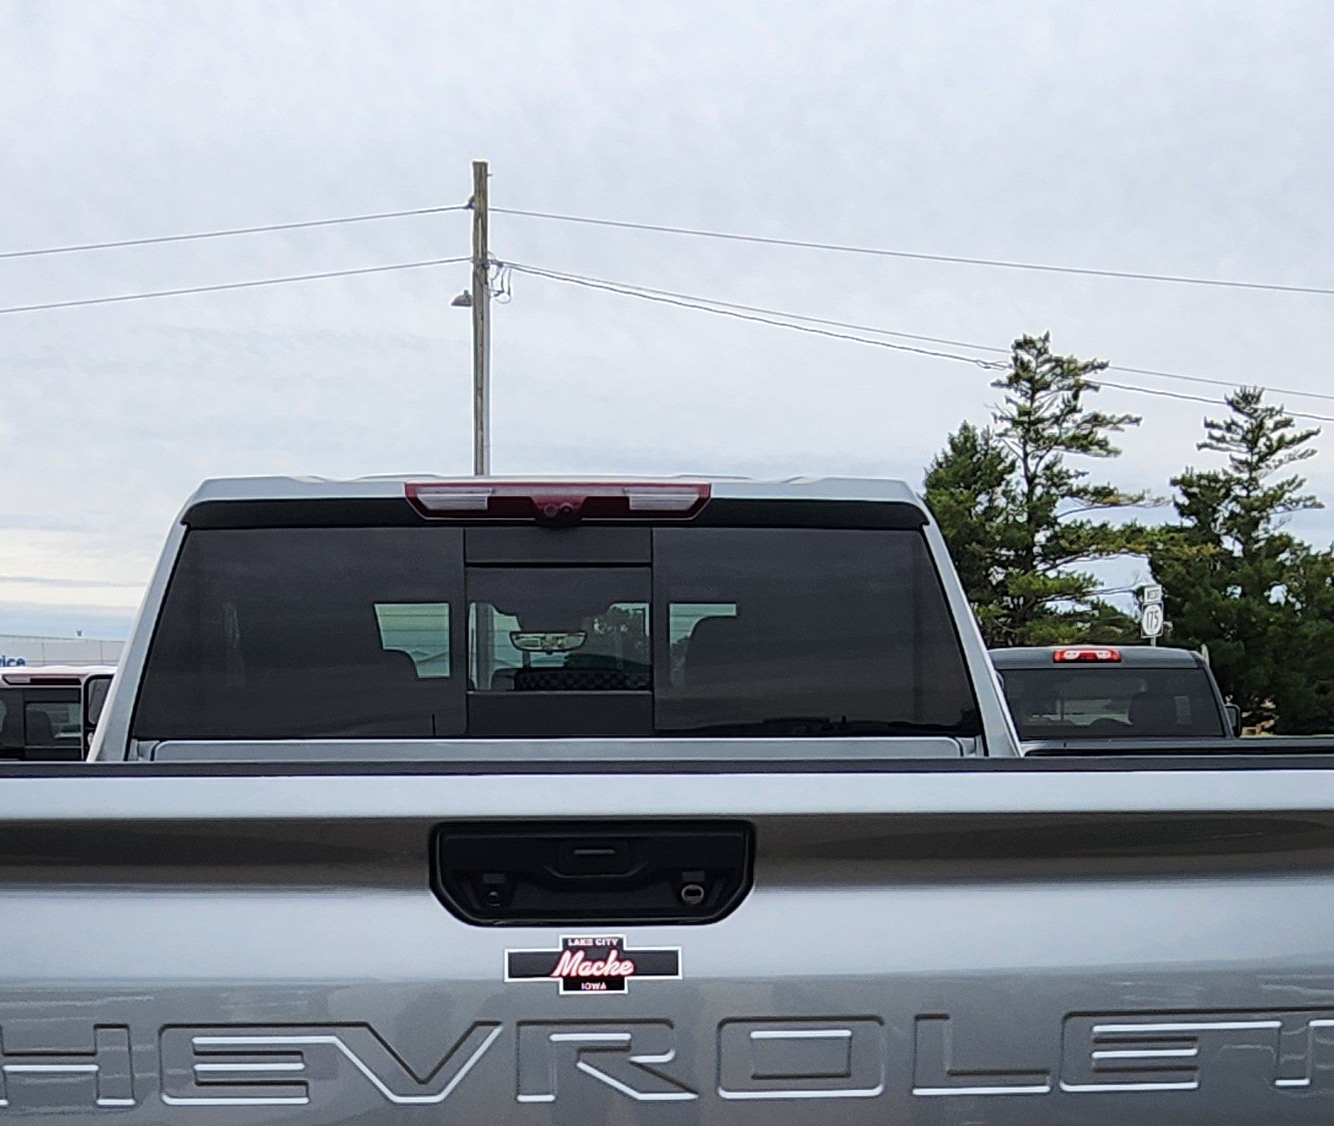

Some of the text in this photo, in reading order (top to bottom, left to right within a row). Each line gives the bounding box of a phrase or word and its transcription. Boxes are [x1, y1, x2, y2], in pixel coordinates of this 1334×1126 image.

[568, 937, 619, 946] LAKE CITY
[550, 949, 634, 978] Macke
[581, 982, 607, 990] IOWA
